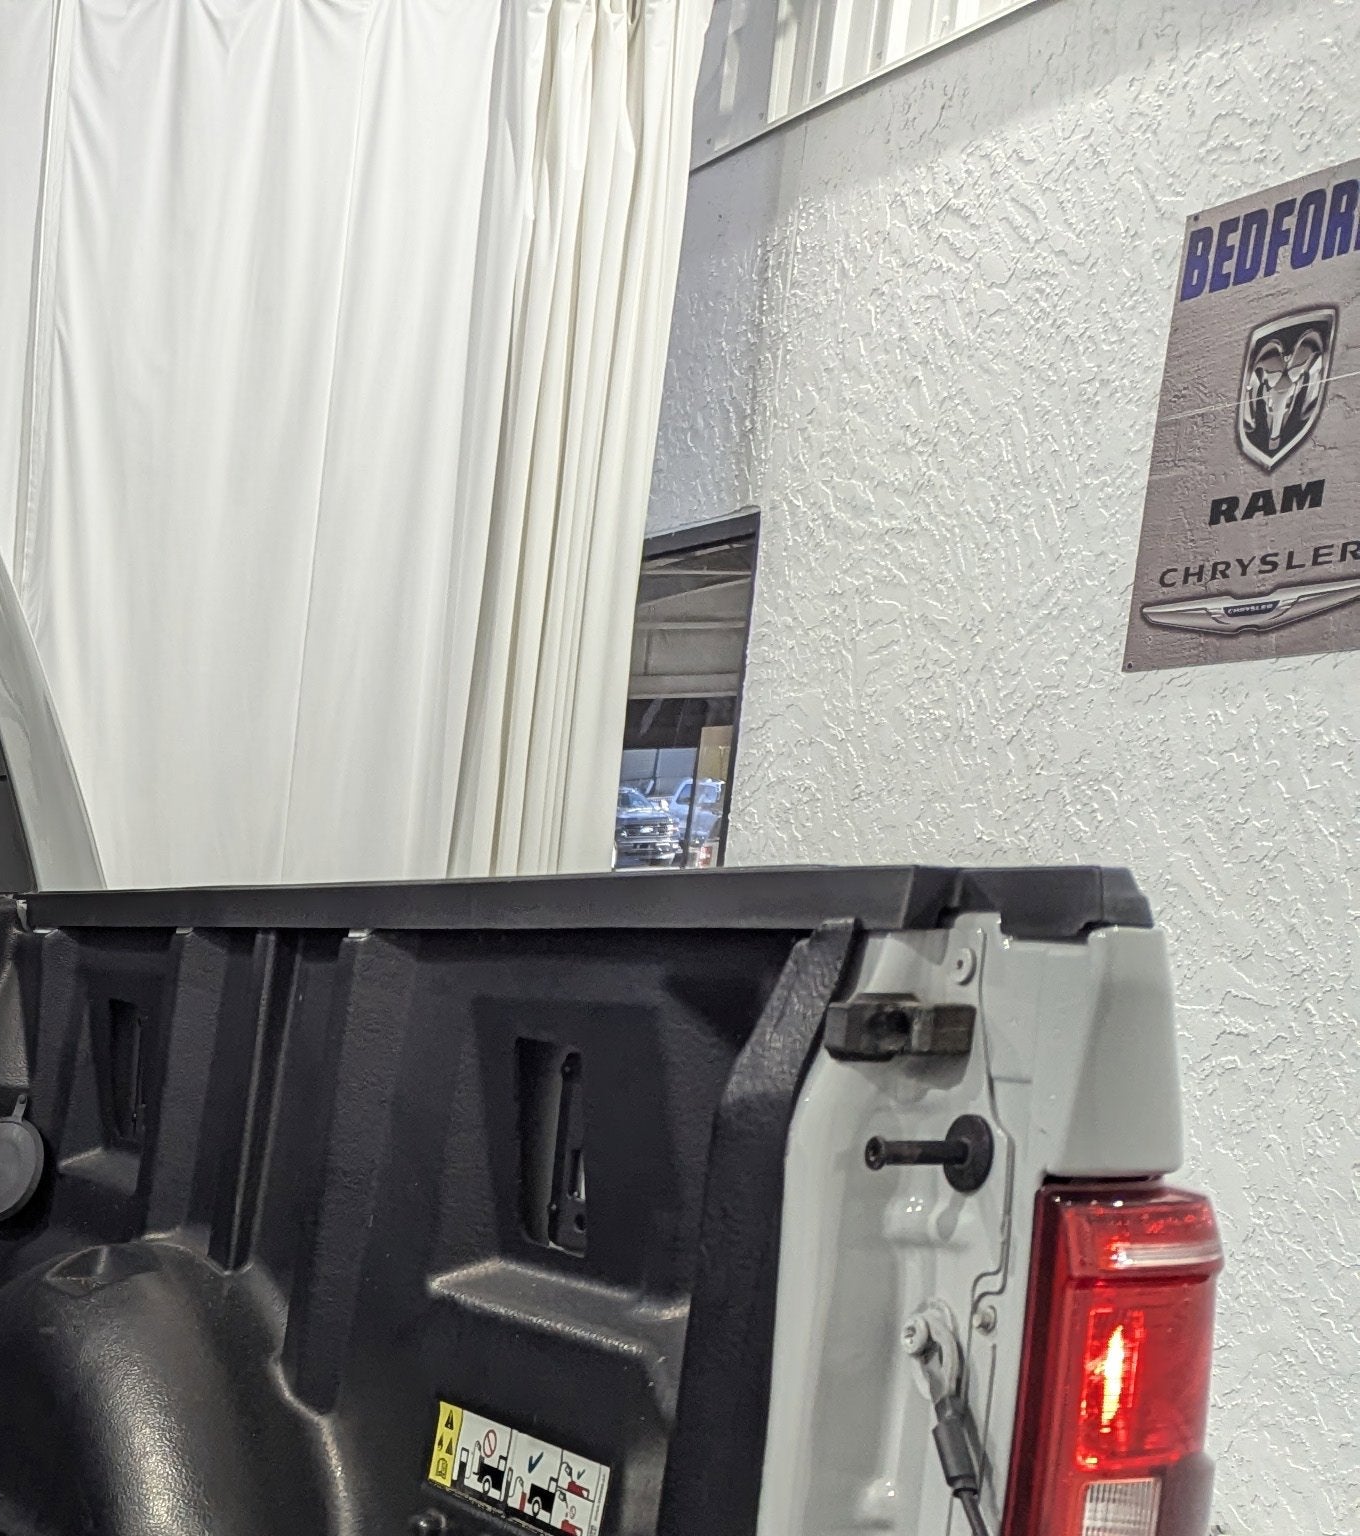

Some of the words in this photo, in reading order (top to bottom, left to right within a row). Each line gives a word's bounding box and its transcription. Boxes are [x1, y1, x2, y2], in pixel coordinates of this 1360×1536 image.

[1180, 179, 1360, 302] BEDFOR
[1209, 478, 1325, 526] RAM
[1159, 541, 1360, 588] CHRYSLER
